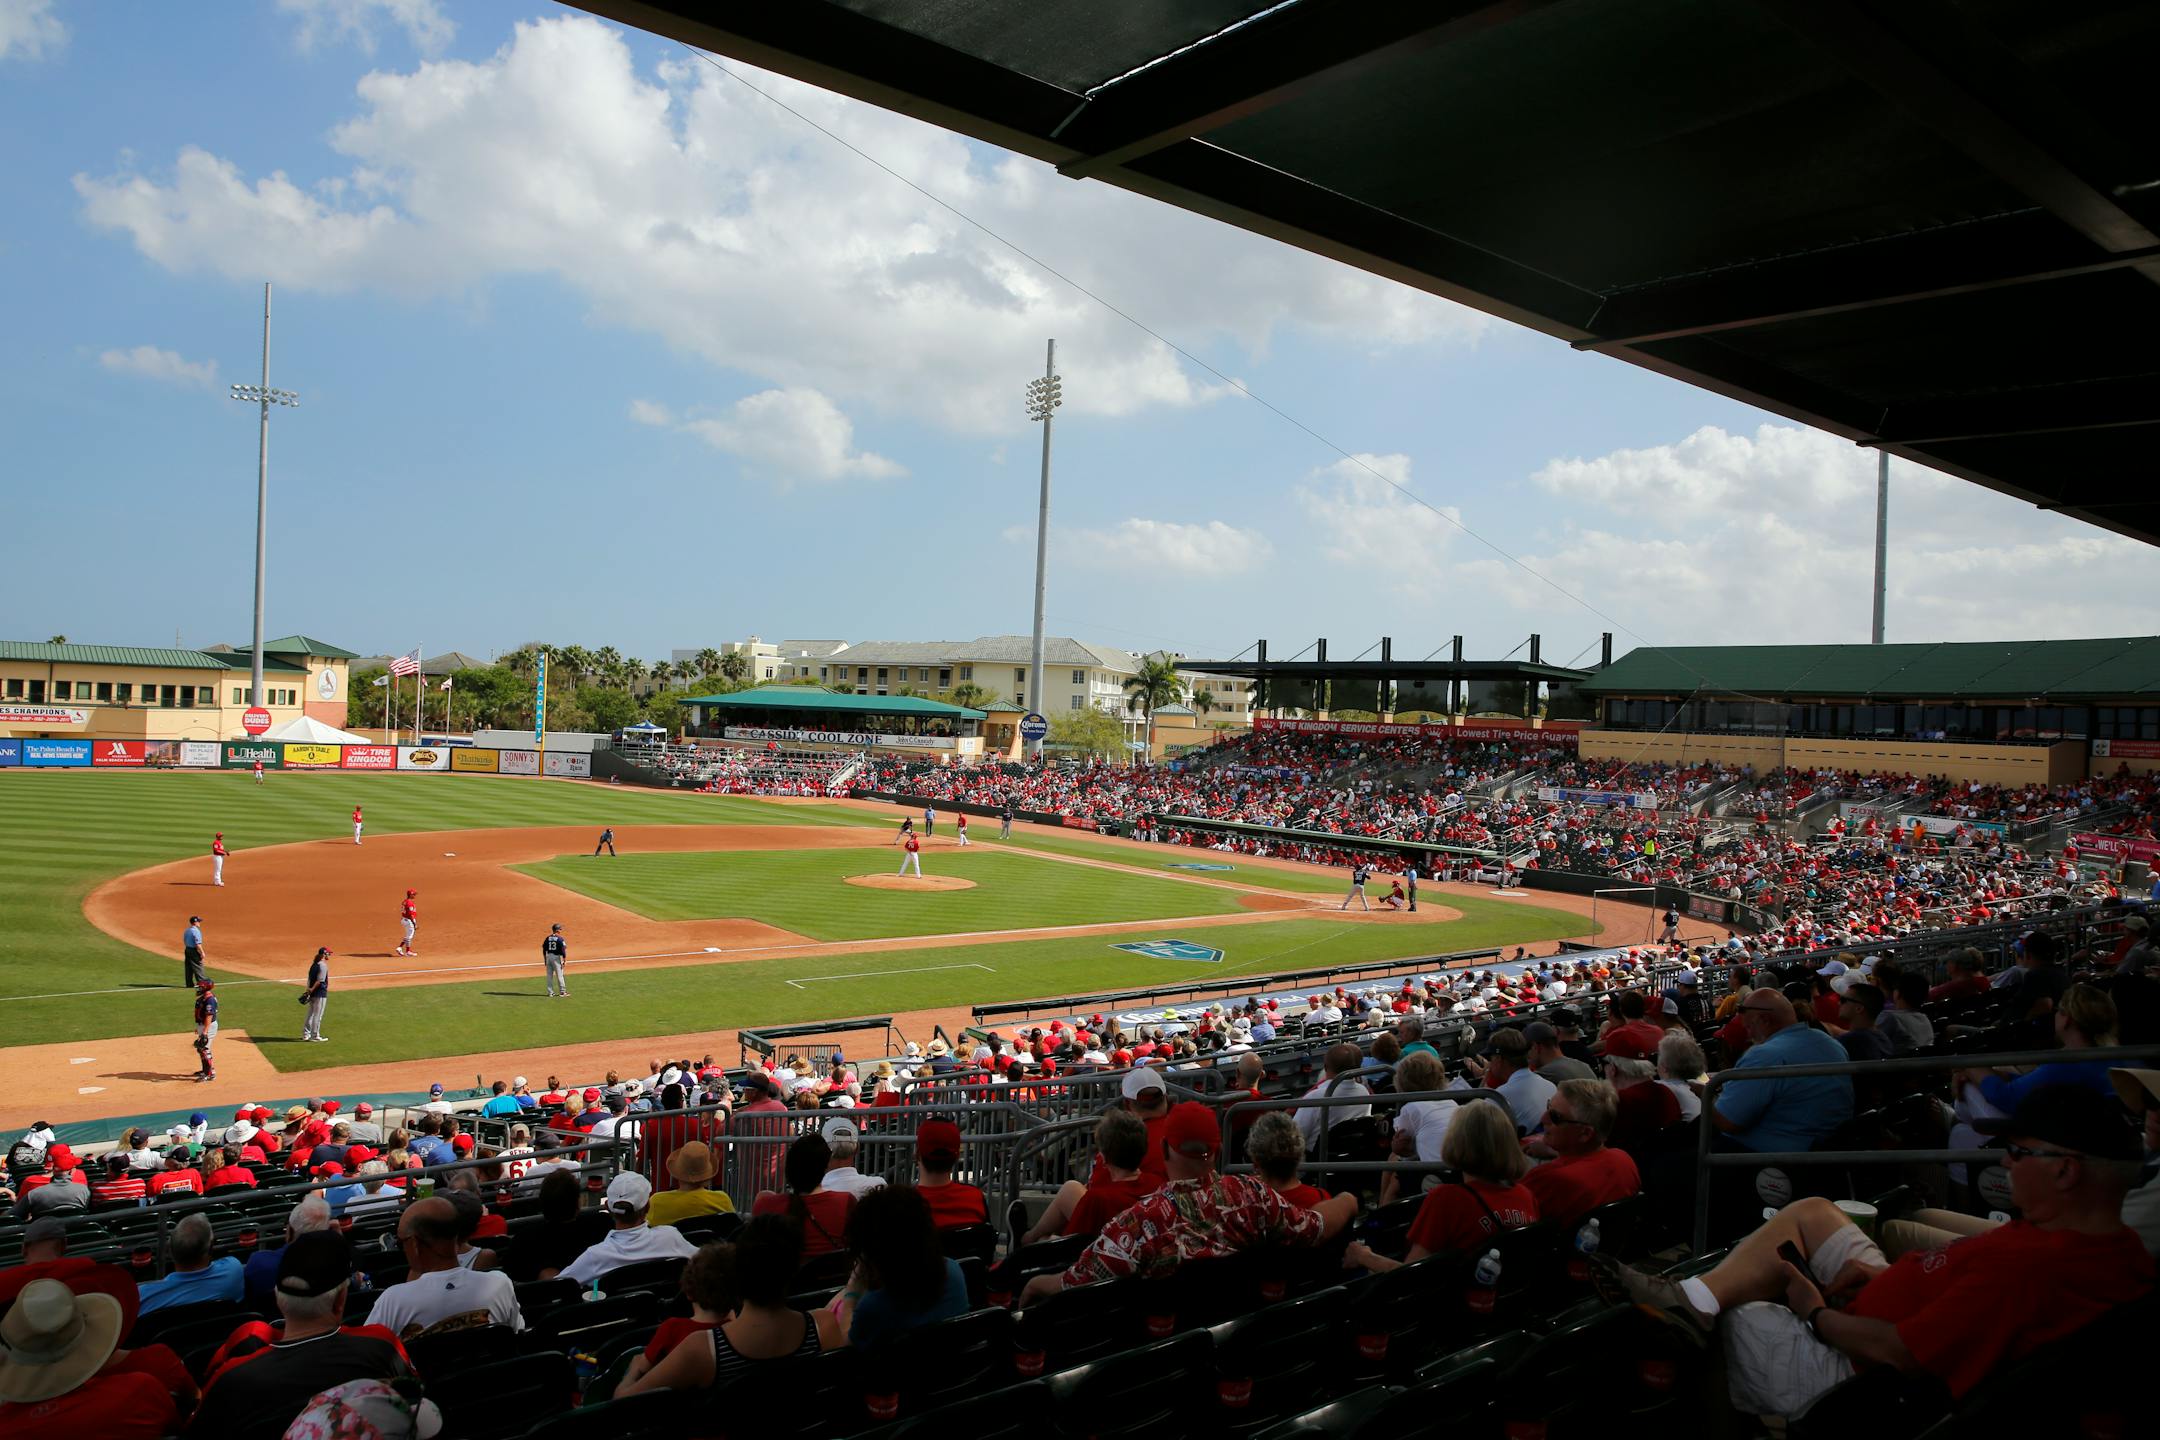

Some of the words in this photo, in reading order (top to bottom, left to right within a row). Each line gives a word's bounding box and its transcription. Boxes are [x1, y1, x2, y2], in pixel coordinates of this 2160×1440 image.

[536, 661, 544, 734] SEACOAST
[1022, 720, 1046, 729] Corona
[1279, 721, 1297, 730] TIRE
[1298, 721, 1336, 731] KINGDOM
[1340, 724, 1376, 733] SERVICE
[1378, 725, 1421, 735] CENTERS
[750, 729, 805, 741] CASSIDY
[808, 732, 844, 743] COOL
[847, 733, 883, 745] ZONE
[1456, 728, 1489, 738] Lowest
[1492, 729, 1511, 739] Tire
[1513, 730, 1538, 740] Price
[26, 745, 39, 753] The
[315, 746, 330, 754] TABLE
[347, 755, 391, 763] KINGDOM
[504, 751, 535, 762] SONNY'S
[566, 757, 585, 765] CODE
[548, 941, 557, 950] 13
